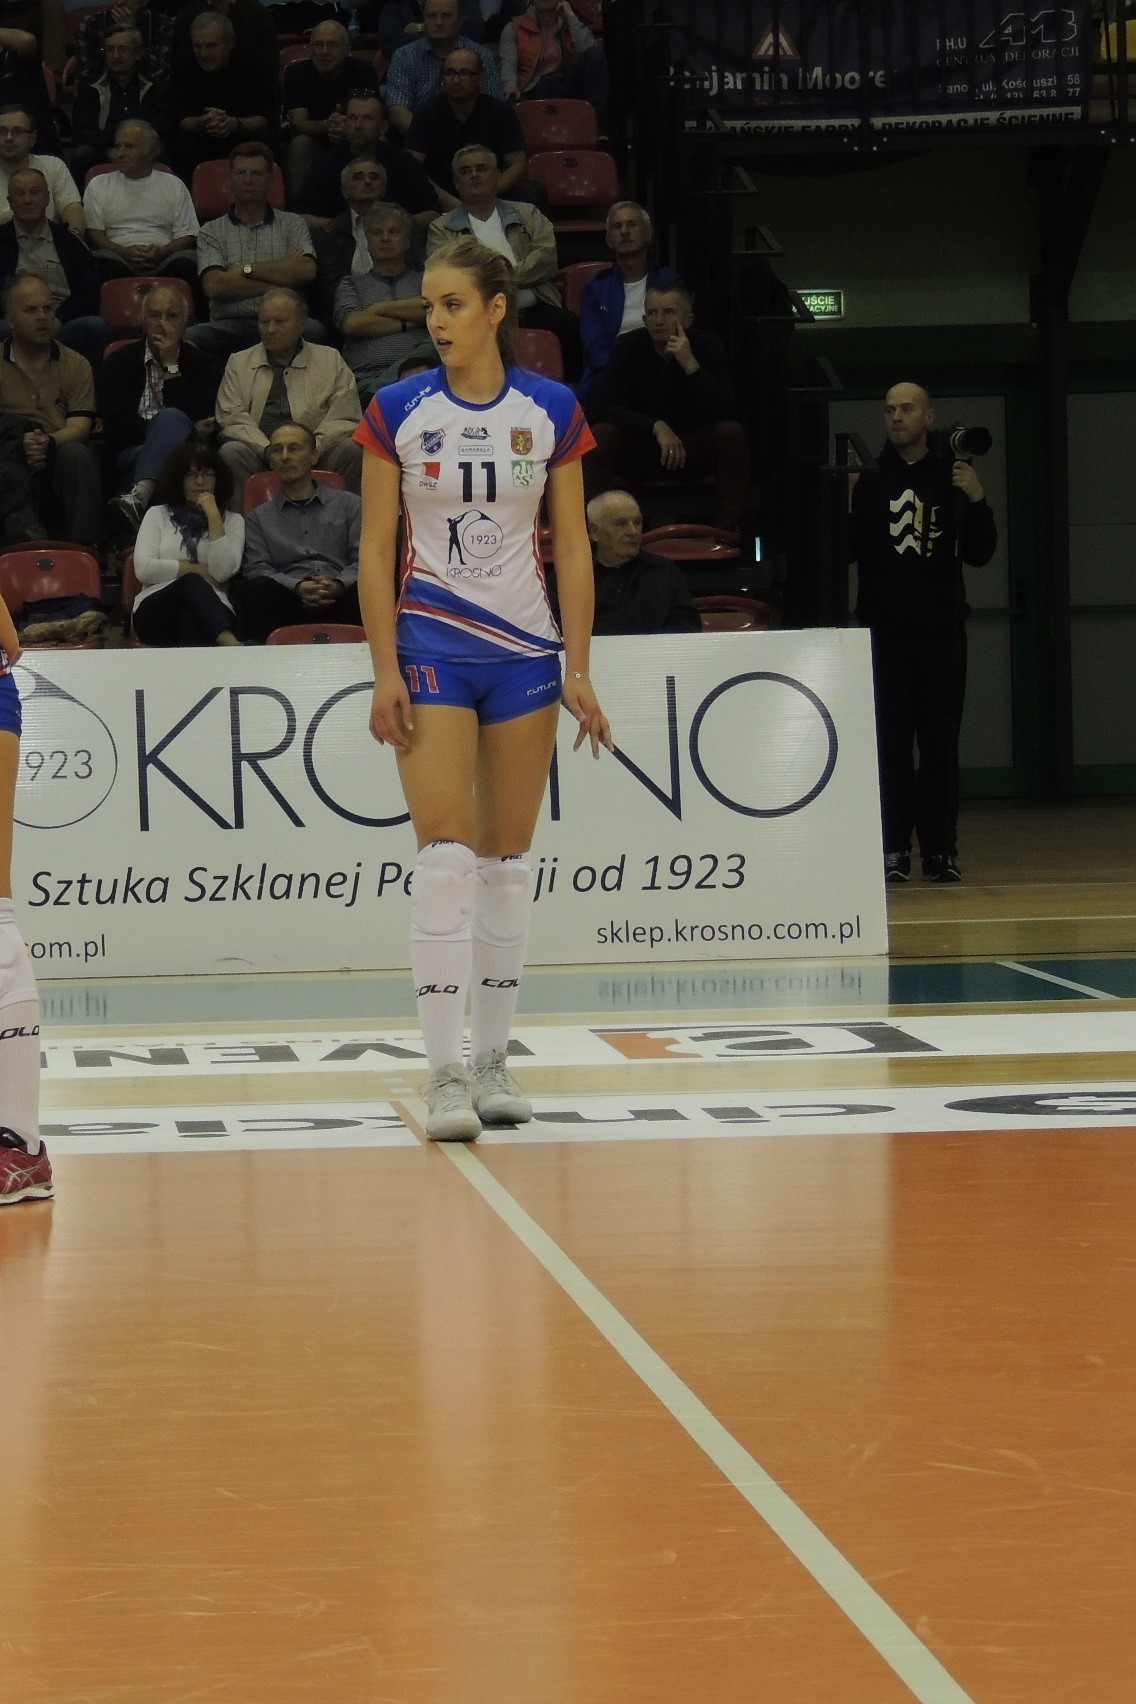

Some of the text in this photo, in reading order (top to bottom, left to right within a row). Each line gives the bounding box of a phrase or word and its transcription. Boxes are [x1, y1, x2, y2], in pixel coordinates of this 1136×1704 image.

[801, 295, 836, 305] JŚCIE
[457, 461, 497, 504] 11
[469, 533, 498, 546] 1923
[446, 564, 503, 579] KROSNO
[405, 665, 440, 694] 11
[25, 749, 94, 782] 923
[135, 671, 838, 832] KRONO
[27, 866, 169, 908] Sztuka
[184, 861, 362, 908] Szklanej
[571, 853, 626, 892] od
[641, 852, 746, 891] 1923
[596, 915, 862, 949] sklep.krosno.com.pl
[481, 977, 520, 989] COL
